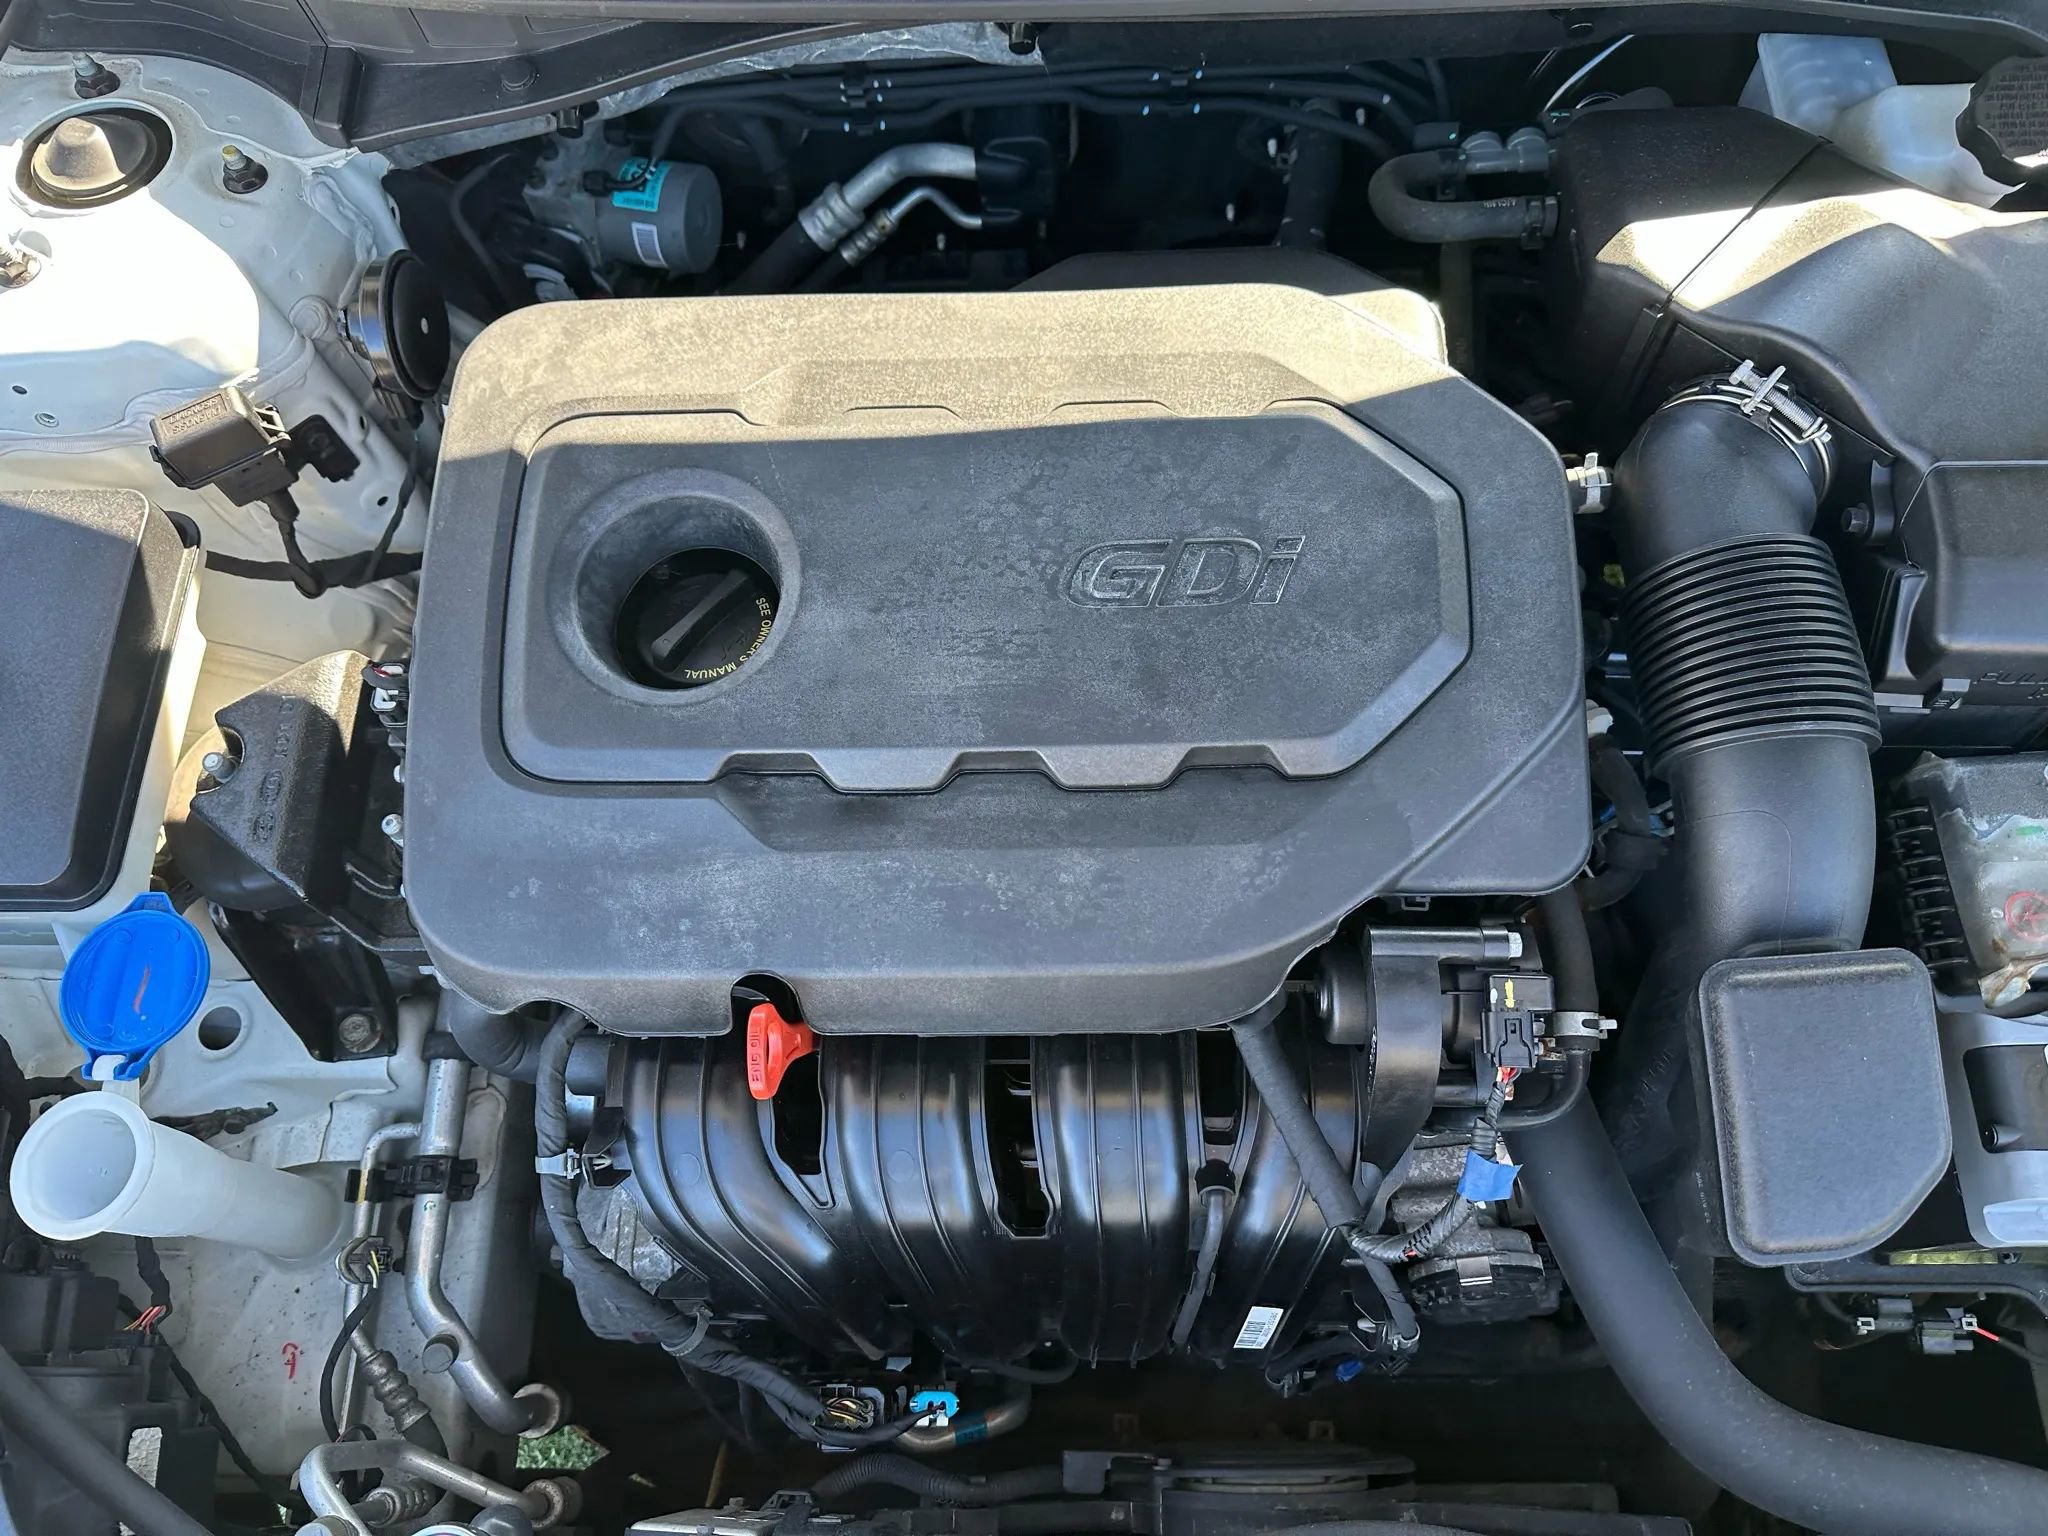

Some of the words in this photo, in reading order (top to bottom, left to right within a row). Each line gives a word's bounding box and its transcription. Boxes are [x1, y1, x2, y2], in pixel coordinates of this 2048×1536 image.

[169, 397, 219, 424] DIAGNOSIS
[1067, 535, 1306, 608] GDi
[755, 597, 771, 617] SEE
[739, 619, 772, 662] OWNERS
[684, 661, 737, 679] MANUAL
[749, 1028, 761, 1049] OIL
[750, 1053, 761, 1083] ENG
